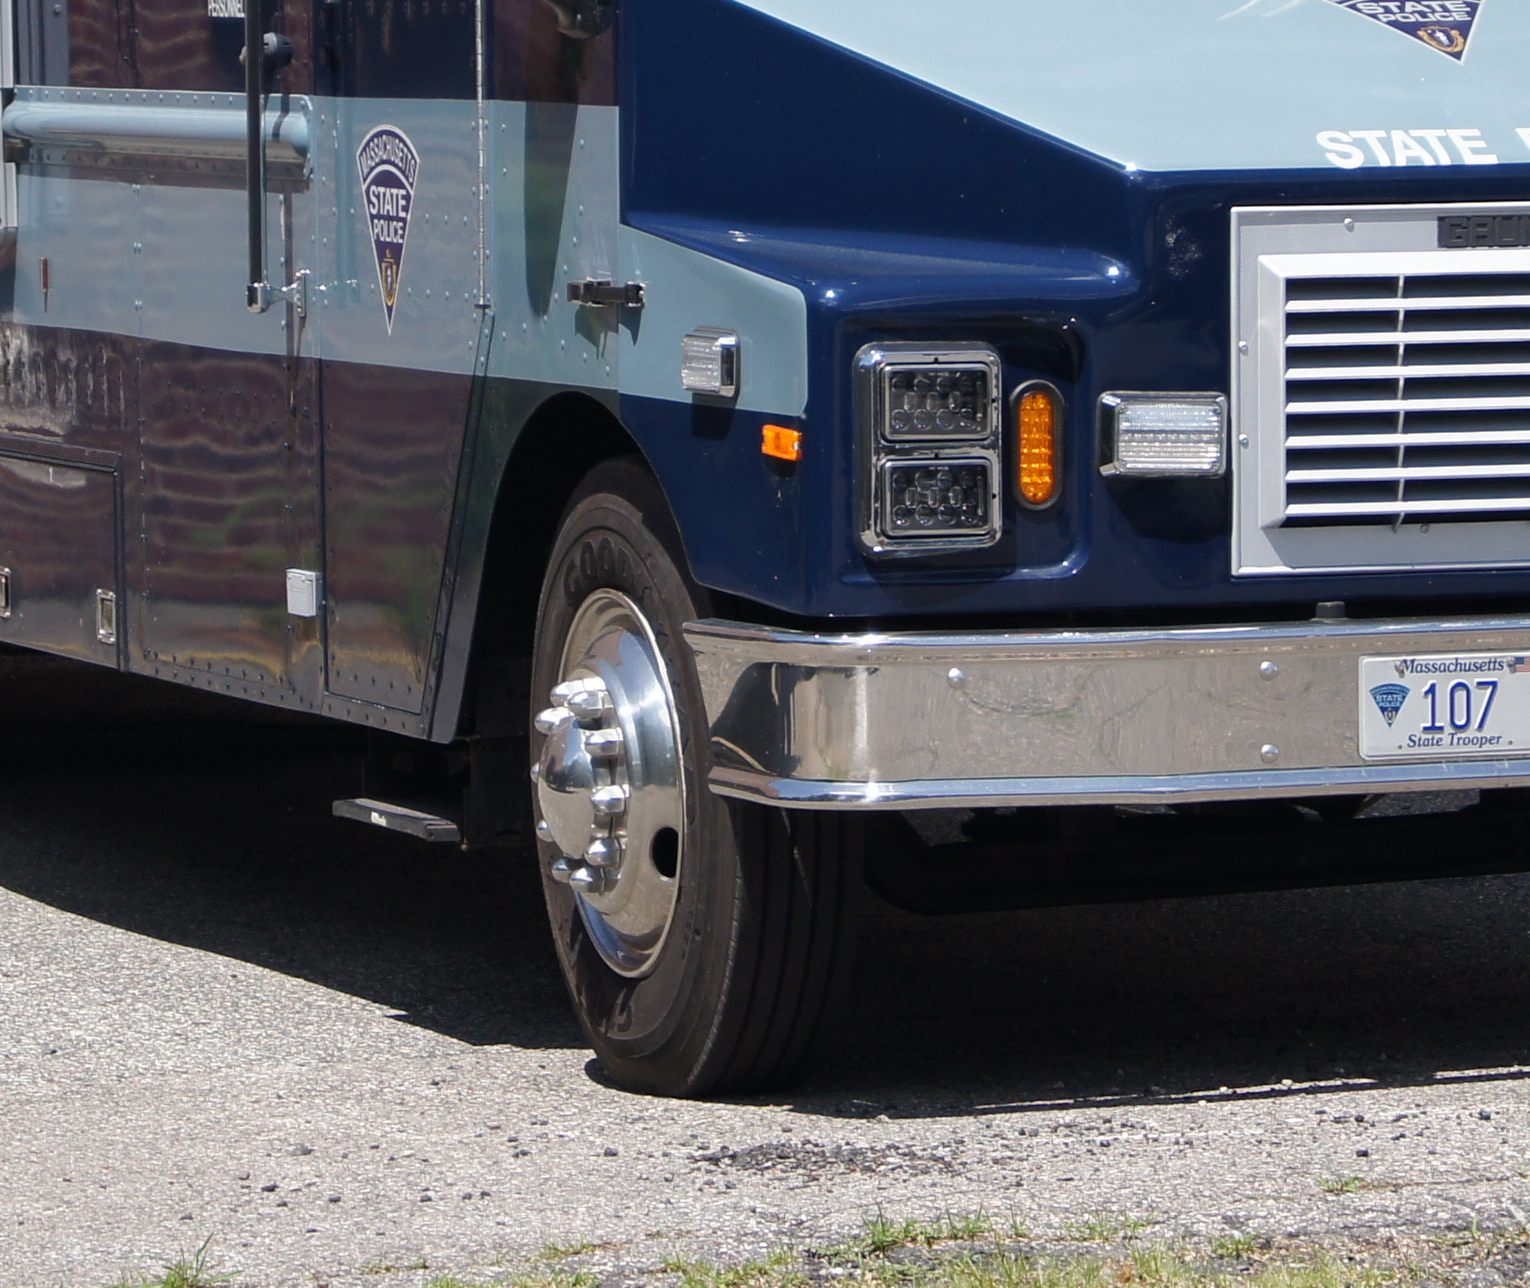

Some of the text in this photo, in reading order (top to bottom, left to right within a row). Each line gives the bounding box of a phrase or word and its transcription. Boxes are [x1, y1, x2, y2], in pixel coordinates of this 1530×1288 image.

[1356, 0, 1471, 14] STATE
[1376, 11, 1472, 23] POLICE
[360, 135, 414, 183] MASSACHUSETTS
[1316, 128, 1498, 169] STATE
[369, 186, 407, 217] STATE
[373, 218, 404, 243] POLICE
[1402, 657, 1505, 674] Massachusetts
[1421, 679, 1498, 733] 107
[1407, 732, 1503, 748] State Trooper
